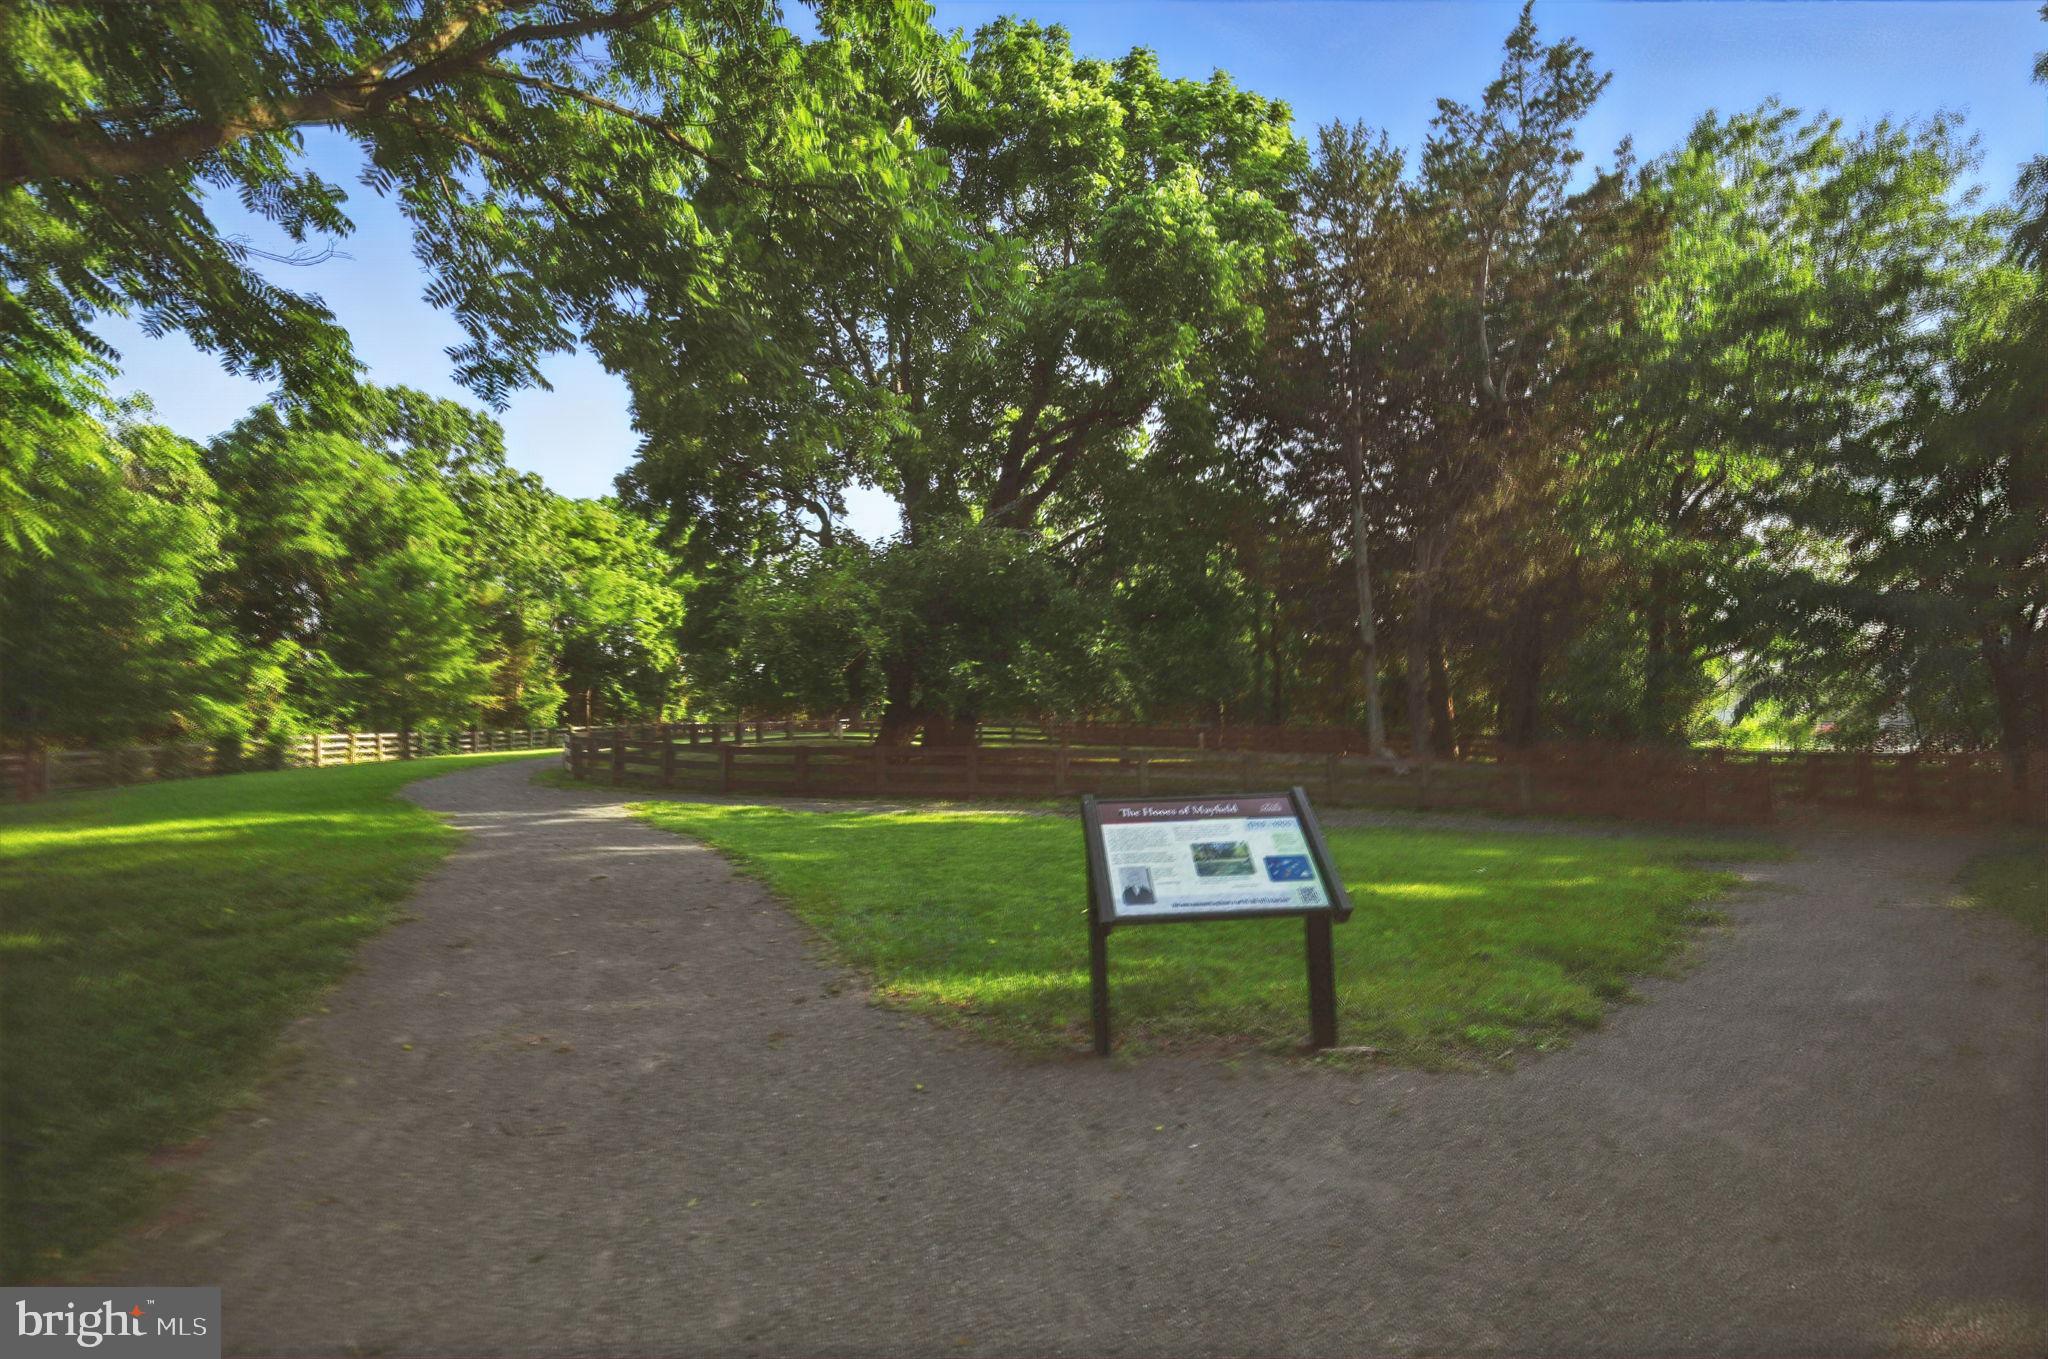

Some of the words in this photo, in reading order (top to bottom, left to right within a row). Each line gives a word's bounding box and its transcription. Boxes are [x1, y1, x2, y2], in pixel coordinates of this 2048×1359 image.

[1119, 807, 1141, 818] The
[1178, 805, 1190, 815] of
[1192, 803, 1239, 817] Mayfield
